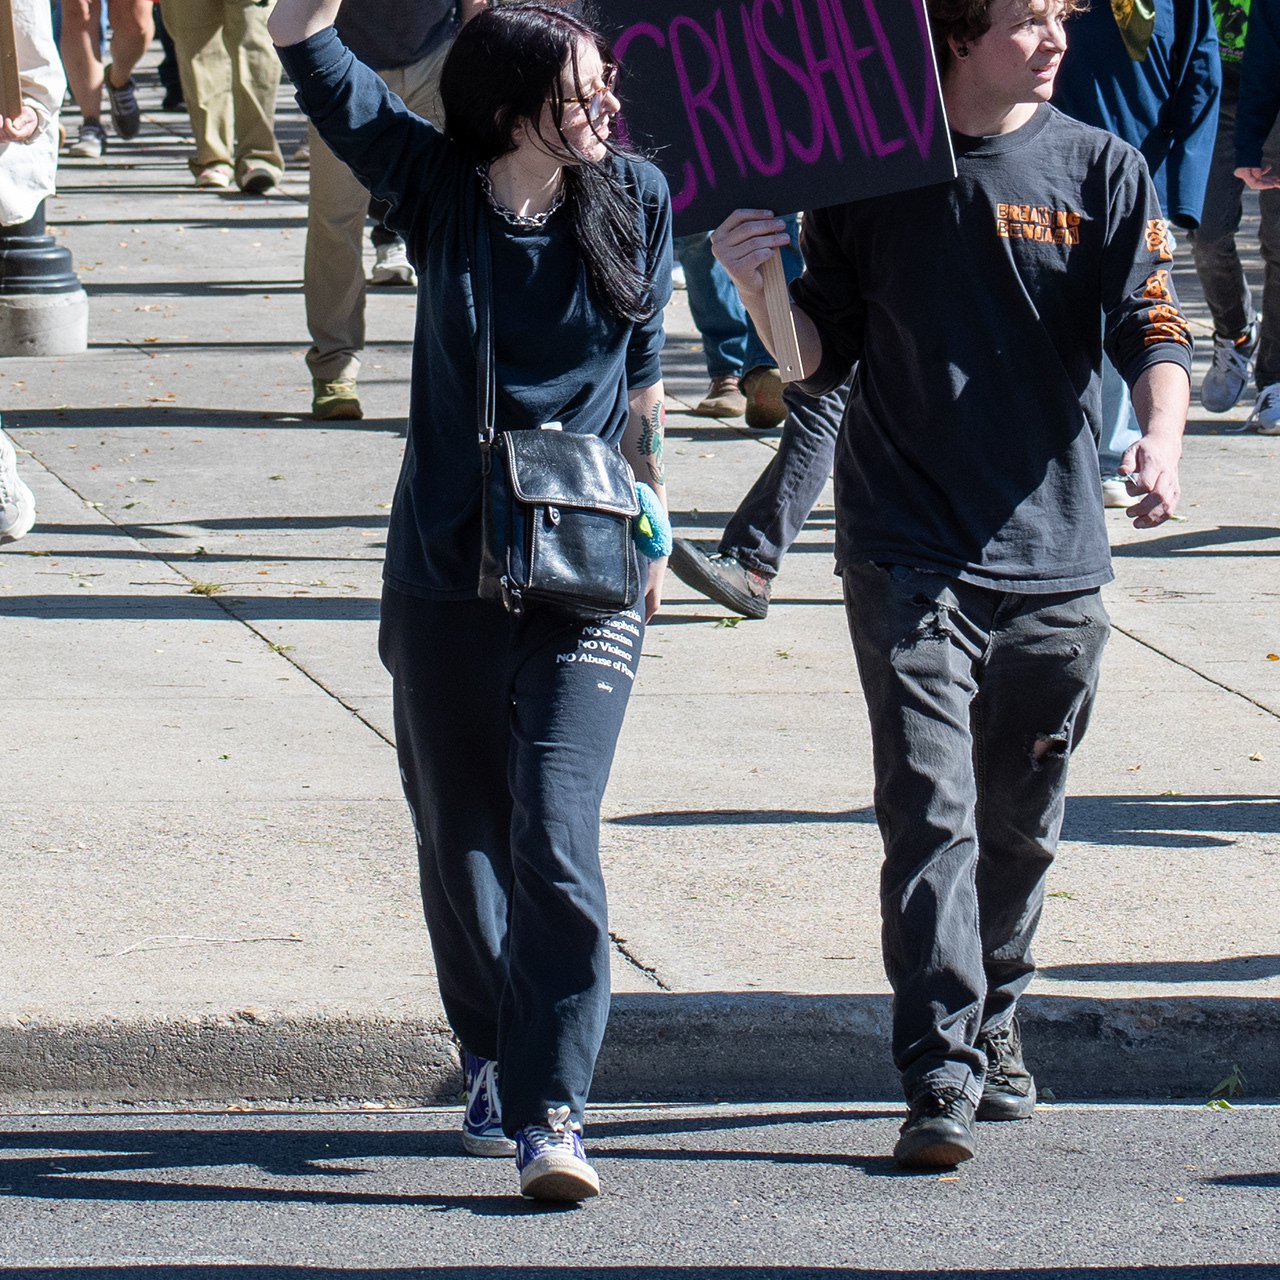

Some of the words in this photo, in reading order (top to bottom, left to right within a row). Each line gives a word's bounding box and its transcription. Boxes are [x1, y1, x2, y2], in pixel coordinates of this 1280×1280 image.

[582, 626, 601, 637] NO
[578, 639, 598, 650] NO
[556, 653, 576, 663] NO
[578, 653, 612, 667] Abuse
